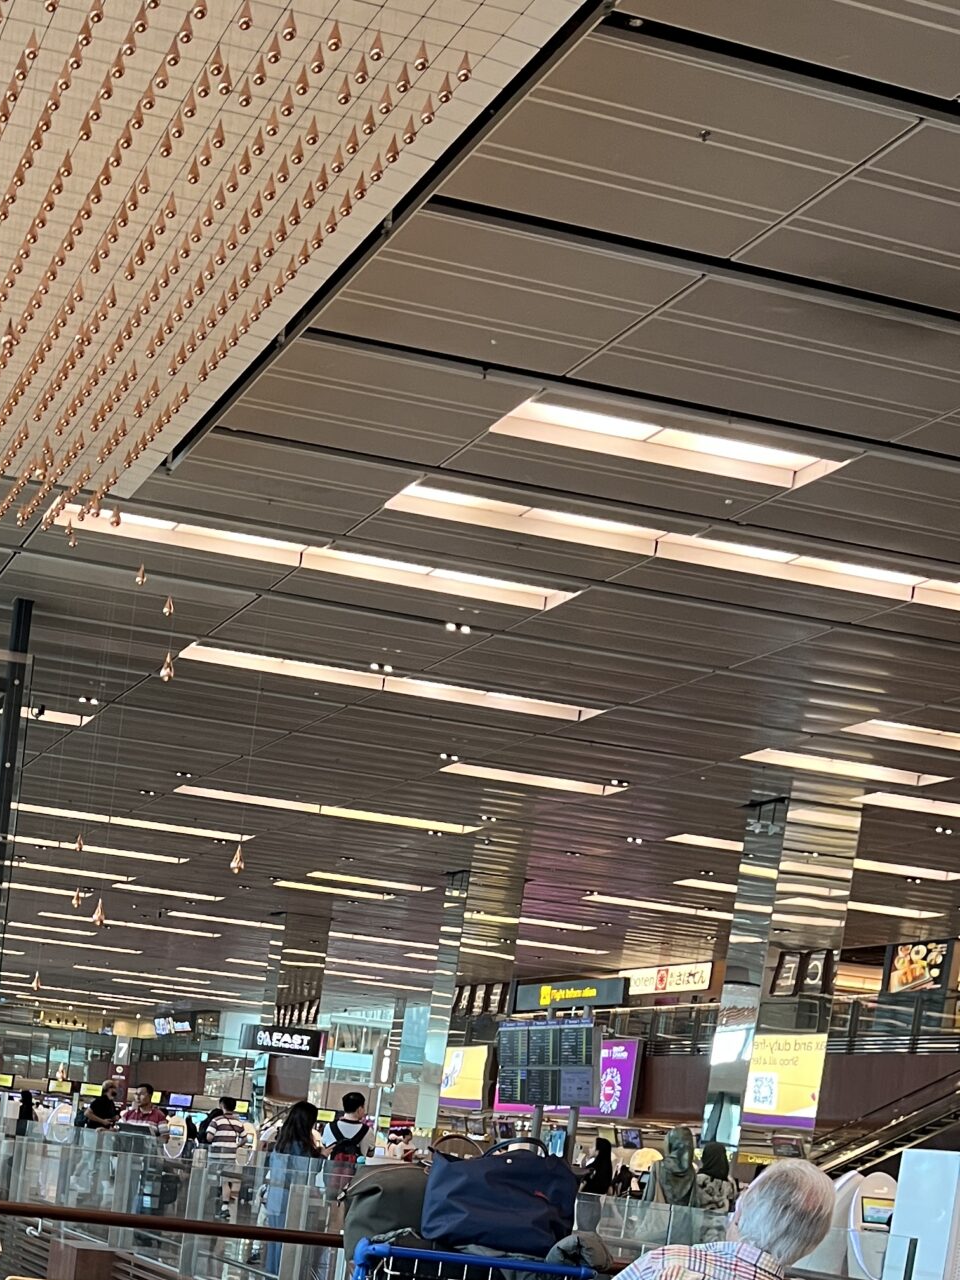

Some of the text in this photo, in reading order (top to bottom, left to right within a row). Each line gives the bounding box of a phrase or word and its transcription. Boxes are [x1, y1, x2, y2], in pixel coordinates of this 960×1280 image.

[551, 987, 597, 1001] Flight Information
[272, 1032, 311, 1045] FAST
[118, 1043, 128, 1058] 7
[748, 1155, 778, 1165] Chargin
